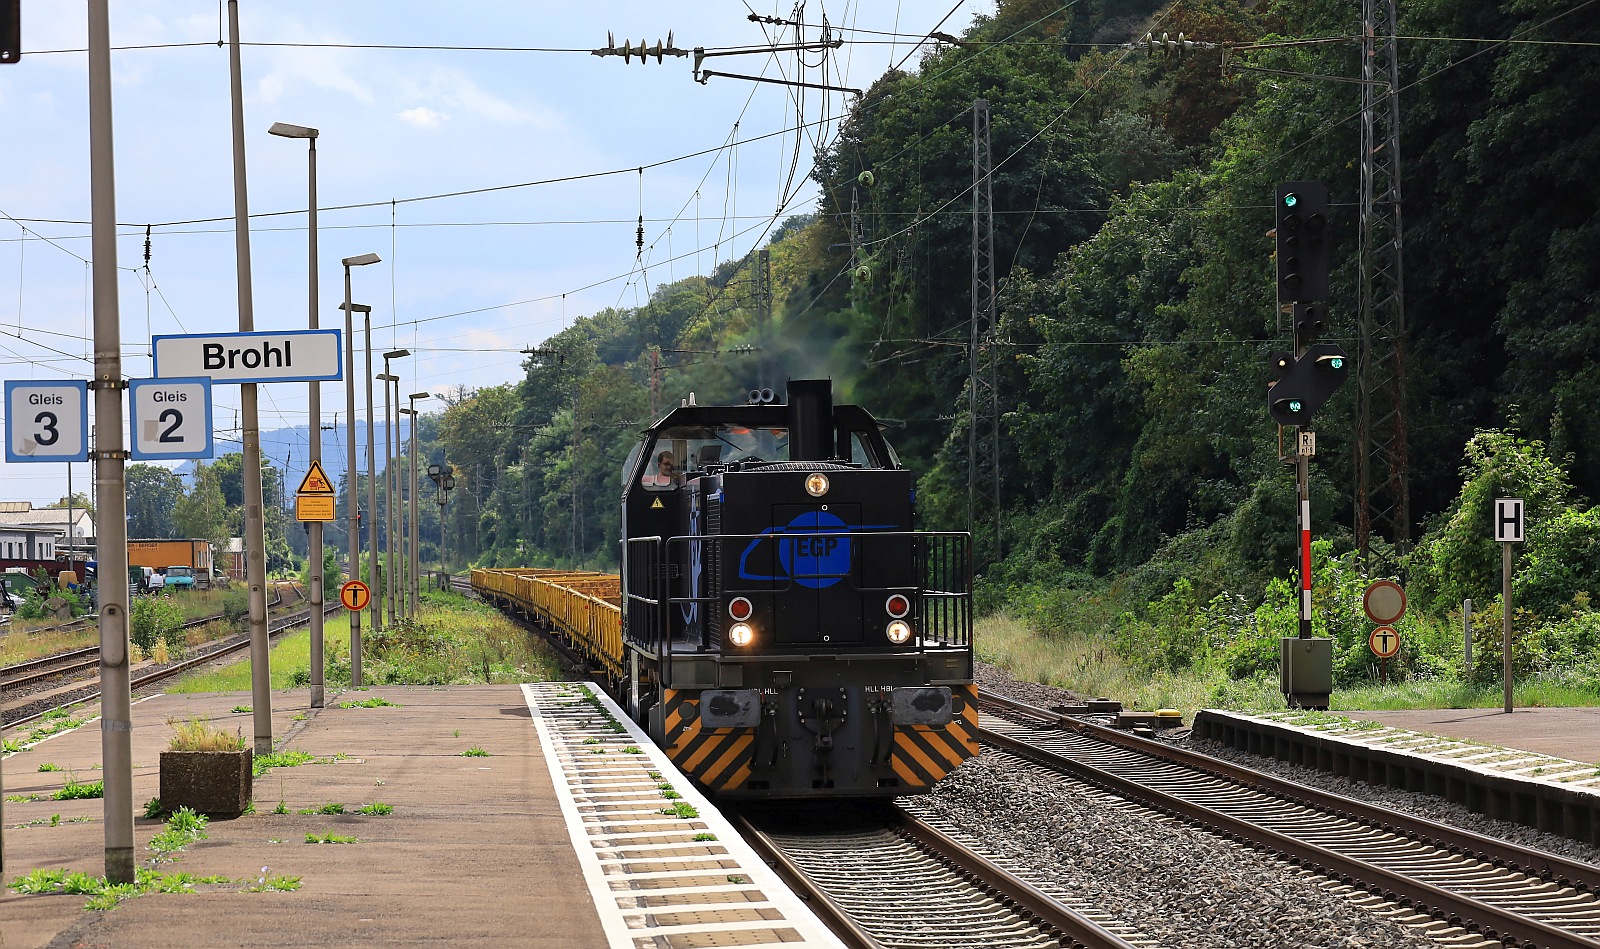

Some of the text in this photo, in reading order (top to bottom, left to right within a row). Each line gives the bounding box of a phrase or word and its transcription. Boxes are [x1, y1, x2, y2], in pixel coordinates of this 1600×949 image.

[203, 341, 292, 370] Brohl
[28, 393, 63, 406] Gleis
[153, 391, 188, 403] Gleis
[33, 411, 60, 446] 3
[158, 408, 185, 444] 2
[1498, 502, 1520, 539] H
[797, 537, 838, 557] EGP
[764, 687, 779, 695] HLL
[864, 685, 879, 693] HLL
